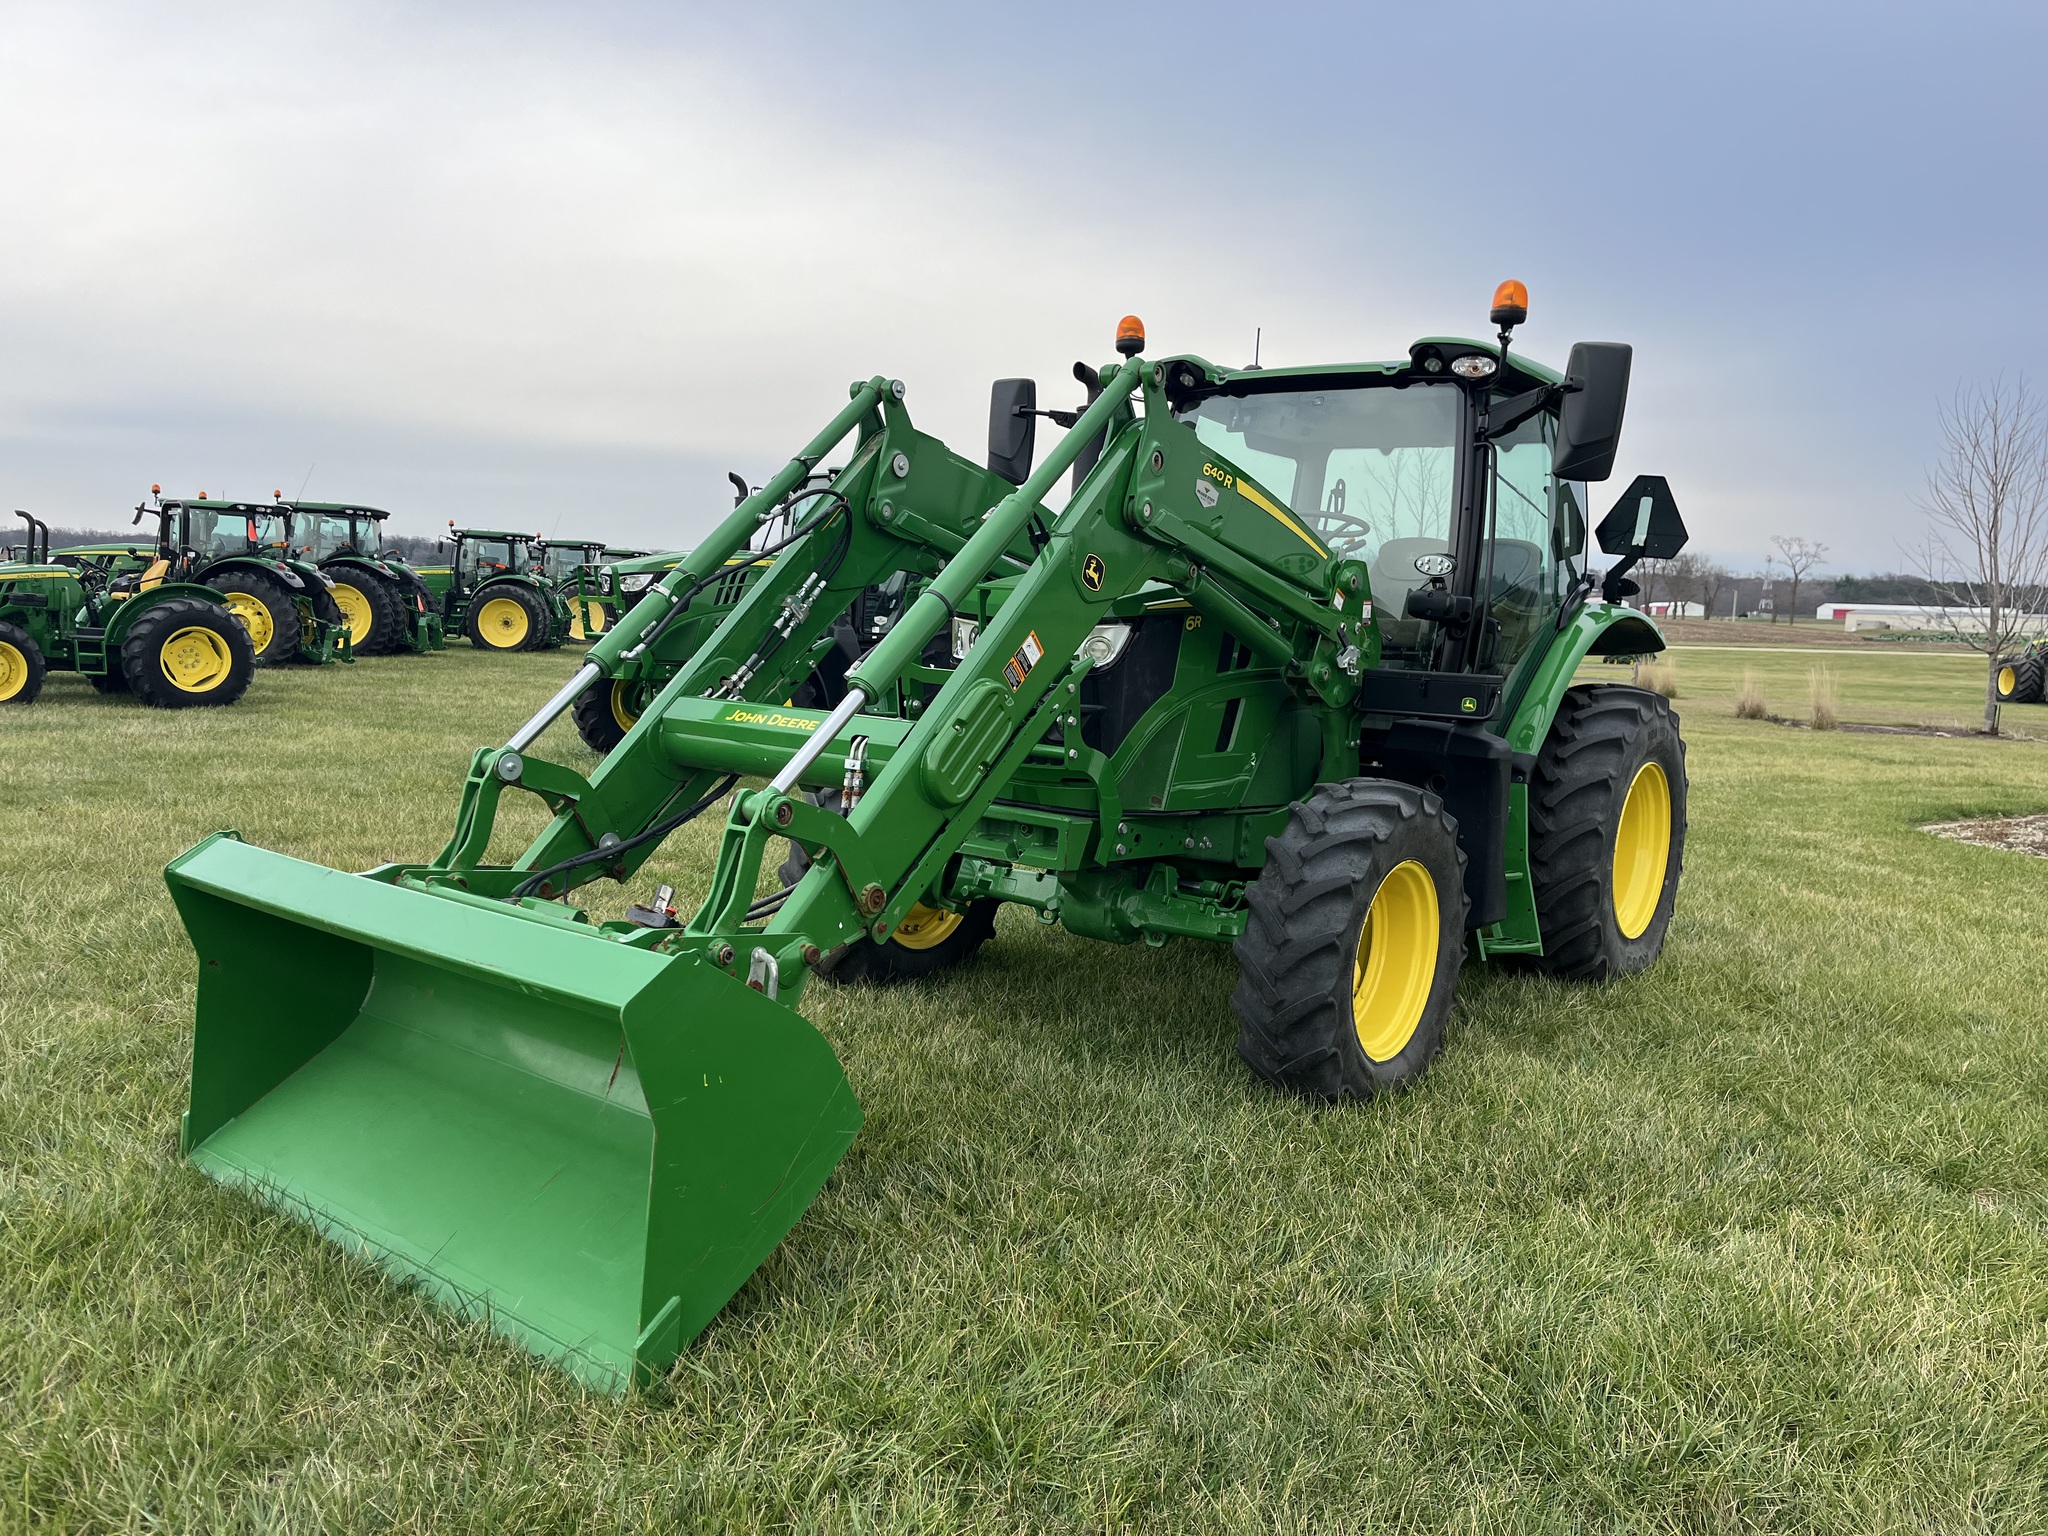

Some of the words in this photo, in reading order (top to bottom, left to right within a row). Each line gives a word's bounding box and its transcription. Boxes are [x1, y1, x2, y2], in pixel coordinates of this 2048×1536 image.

[1203, 463, 1233, 489] 640R
[1186, 615, 1202, 631] 6R
[725, 709, 768, 724] JOHN
[766, 713, 820, 731] DEERE
